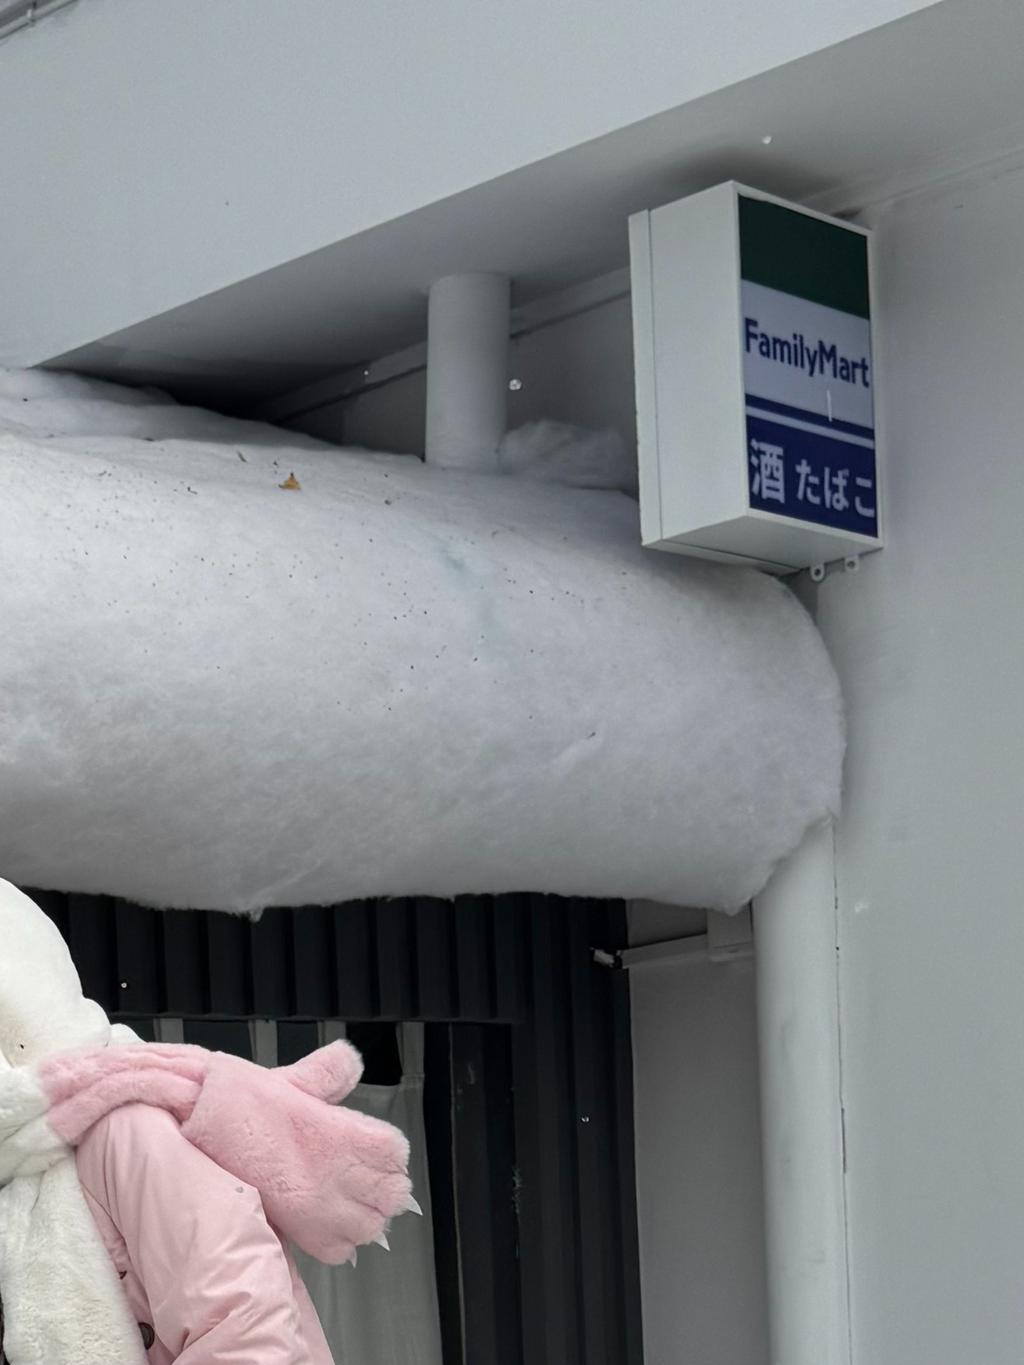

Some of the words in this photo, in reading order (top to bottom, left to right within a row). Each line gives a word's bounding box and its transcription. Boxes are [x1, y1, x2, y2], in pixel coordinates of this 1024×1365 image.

[744, 317, 870, 389] FamilyMart
[750, 438, 785, 504] 酒
[795, 459, 875, 518] たばこ
